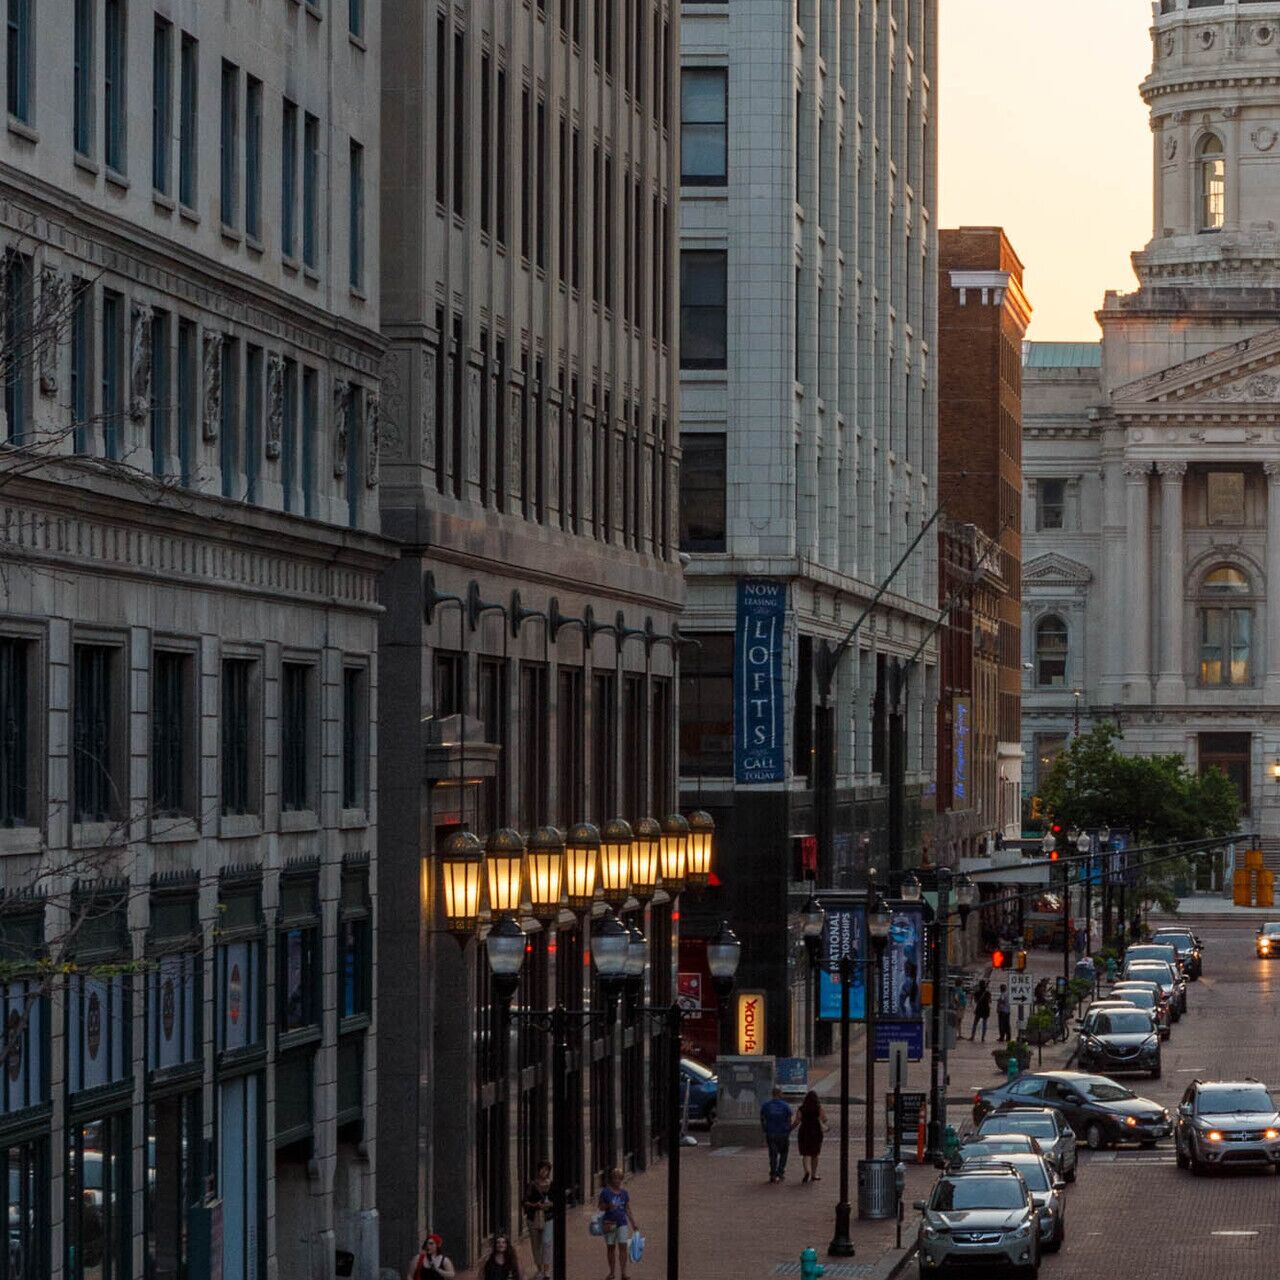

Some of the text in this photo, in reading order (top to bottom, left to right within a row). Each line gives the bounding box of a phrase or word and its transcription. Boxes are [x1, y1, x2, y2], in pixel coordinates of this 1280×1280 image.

[745, 585, 778, 596] NOW
[744, 598, 777, 606] LEASING
[749, 621, 769, 745] LOFTS
[743, 758, 776, 769] CALL
[745, 772, 775, 780] TODAY
[830, 912, 841, 970] NATIONAL
